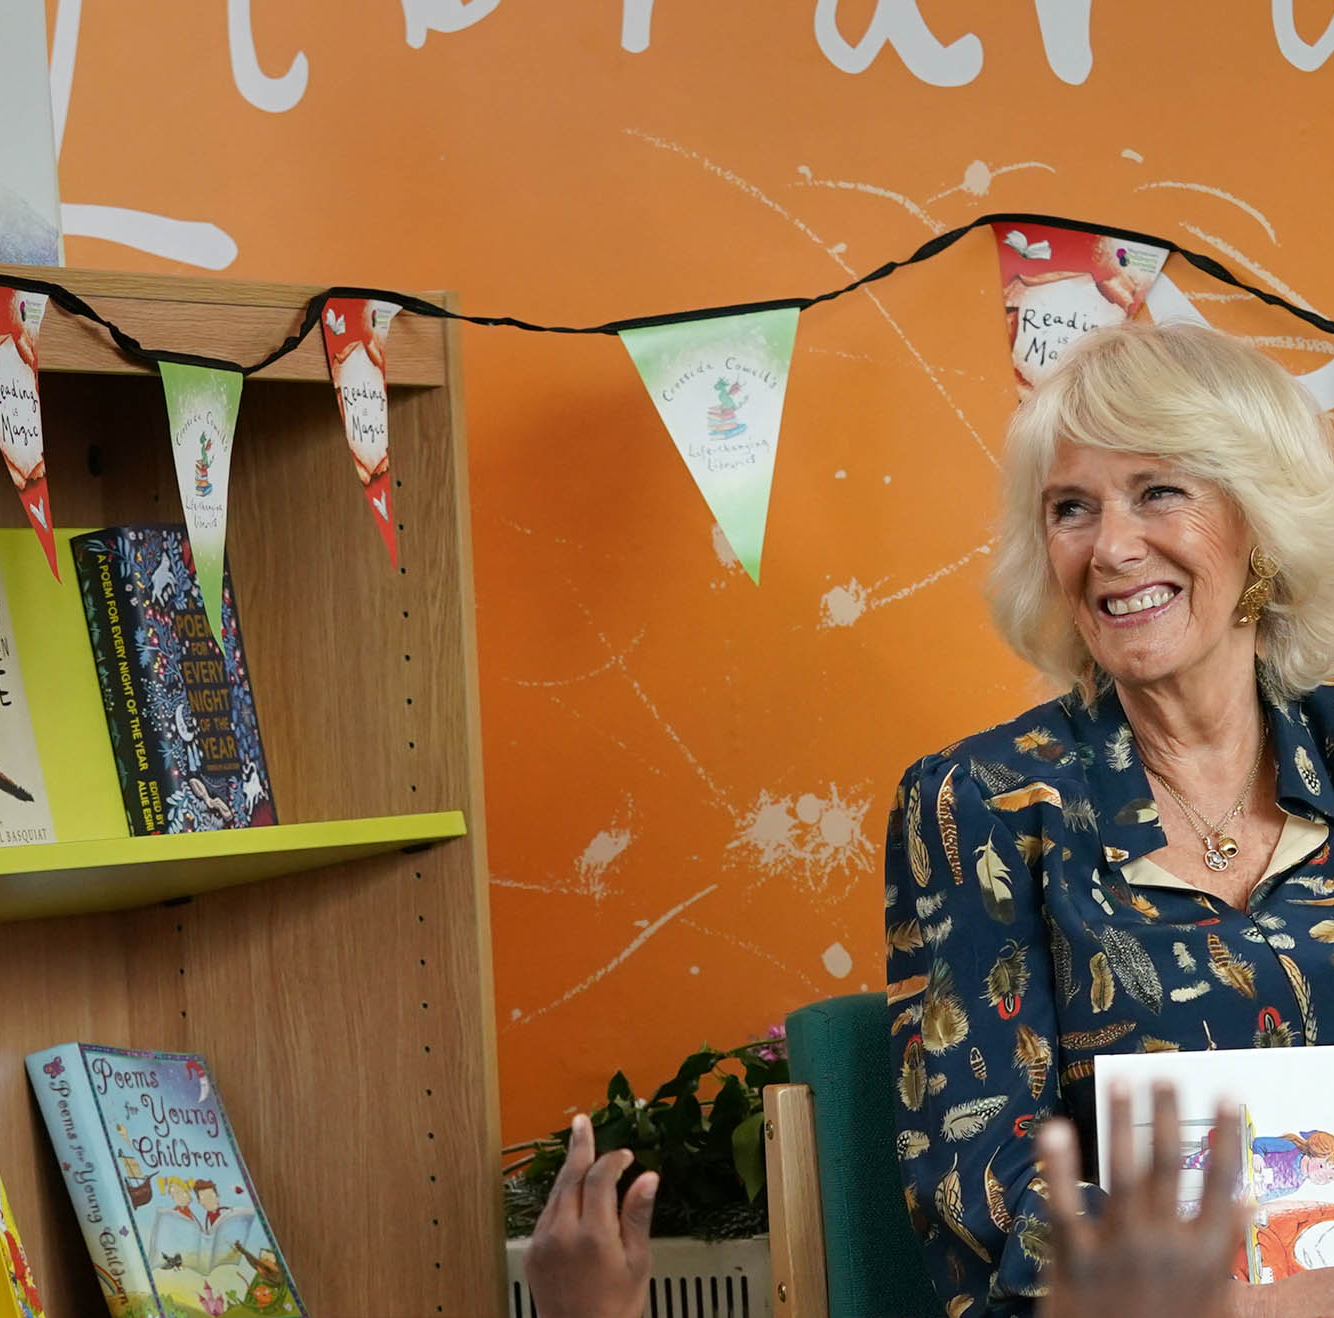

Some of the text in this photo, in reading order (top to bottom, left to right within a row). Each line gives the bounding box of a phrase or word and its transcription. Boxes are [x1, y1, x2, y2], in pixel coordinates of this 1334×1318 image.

[1022, 308, 1099, 333] Readi
[343, 381, 386, 412] Reading
[662, 360, 715, 403] Cressida
[1, 413, 39, 446] Magic
[351, 413, 385, 444] Magic
[97, 554, 149, 771] A POEM FOR EVERY NIGHT OF THE YEAR
[183, 661, 224, 684] EVERY
[188, 688, 229, 713] NIGHT
[200, 735, 237, 759] YEAR
[149, 781, 165, 825] EDITED BY
[6, 828, 48, 844] BASQUIAT
[92, 1057, 160, 1095] Poems
[123, 1093, 219, 1138] for Young
[132, 1135, 229, 1170] Children
[49, 1079, 129, 1305] Poems for Young Children
